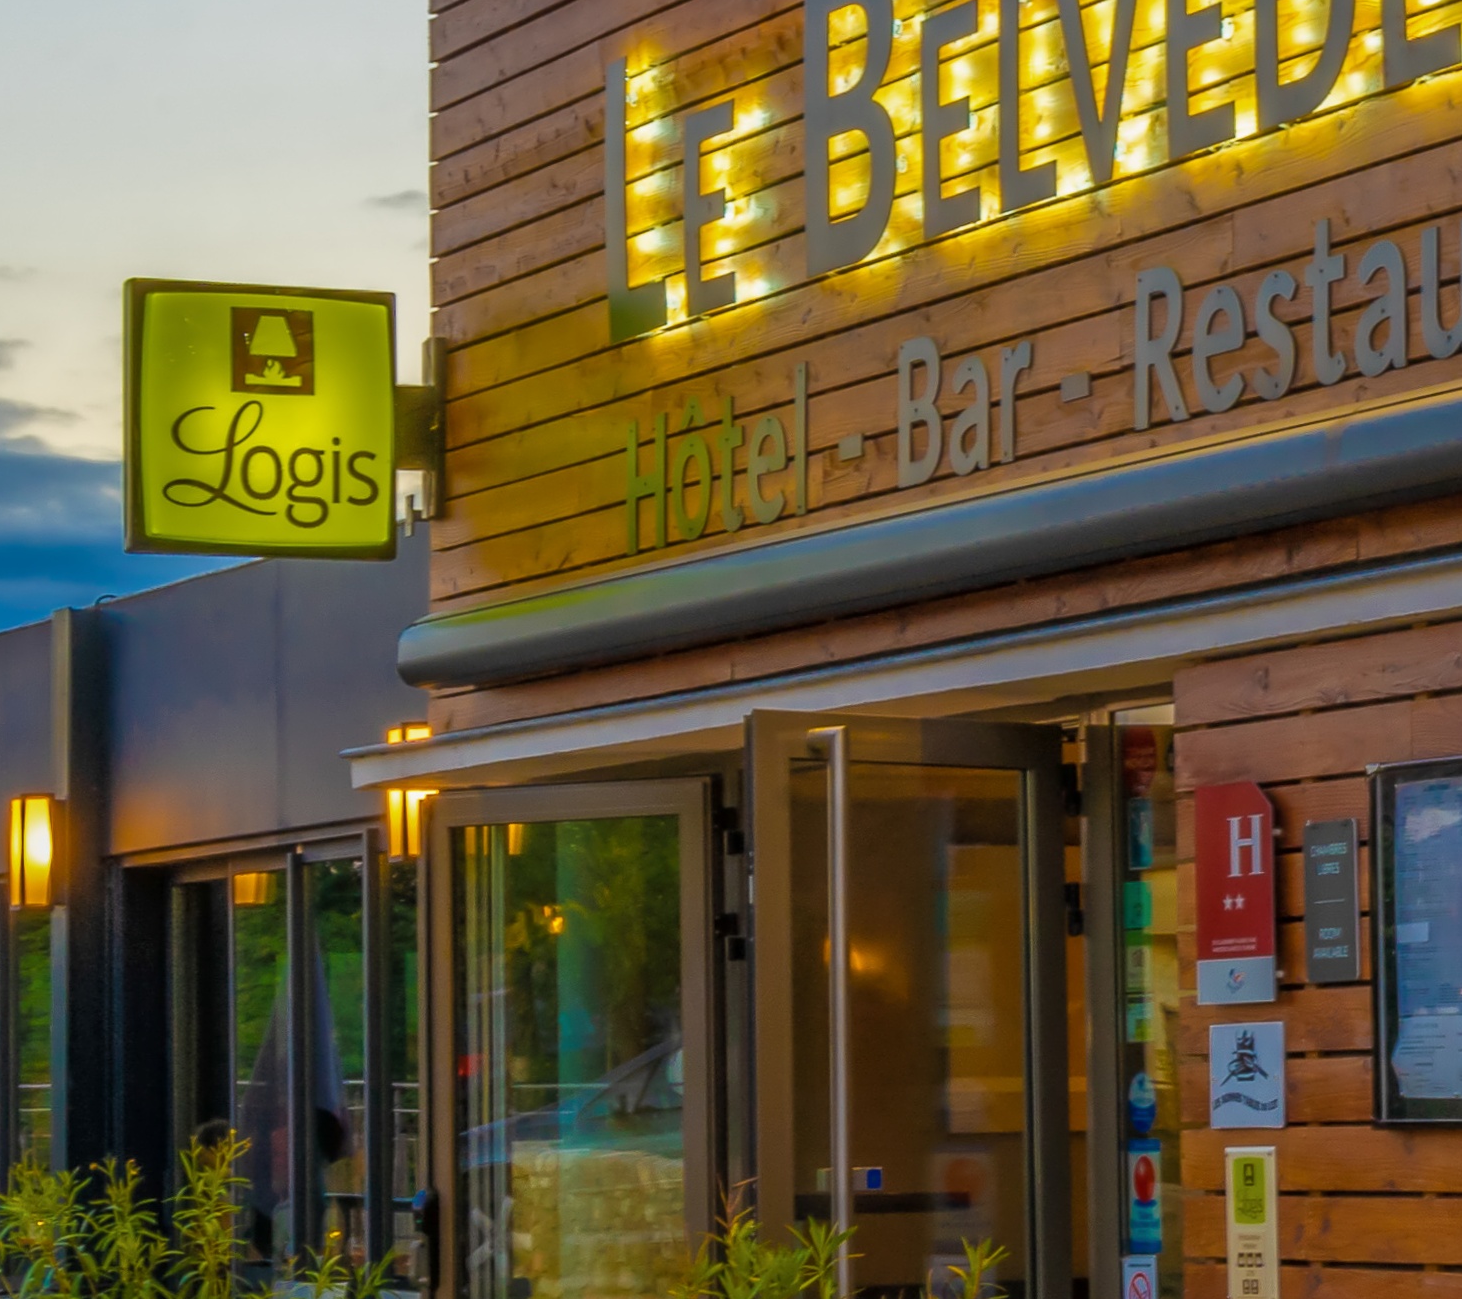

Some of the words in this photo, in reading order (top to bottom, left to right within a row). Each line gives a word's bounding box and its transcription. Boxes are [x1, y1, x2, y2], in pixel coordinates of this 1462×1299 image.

[162, 400, 380, 528] Logis
[626, 360, 808, 556] Hôtel
[897, 336, 1034, 489] Bar
[1226, 813, 1266, 878] H
